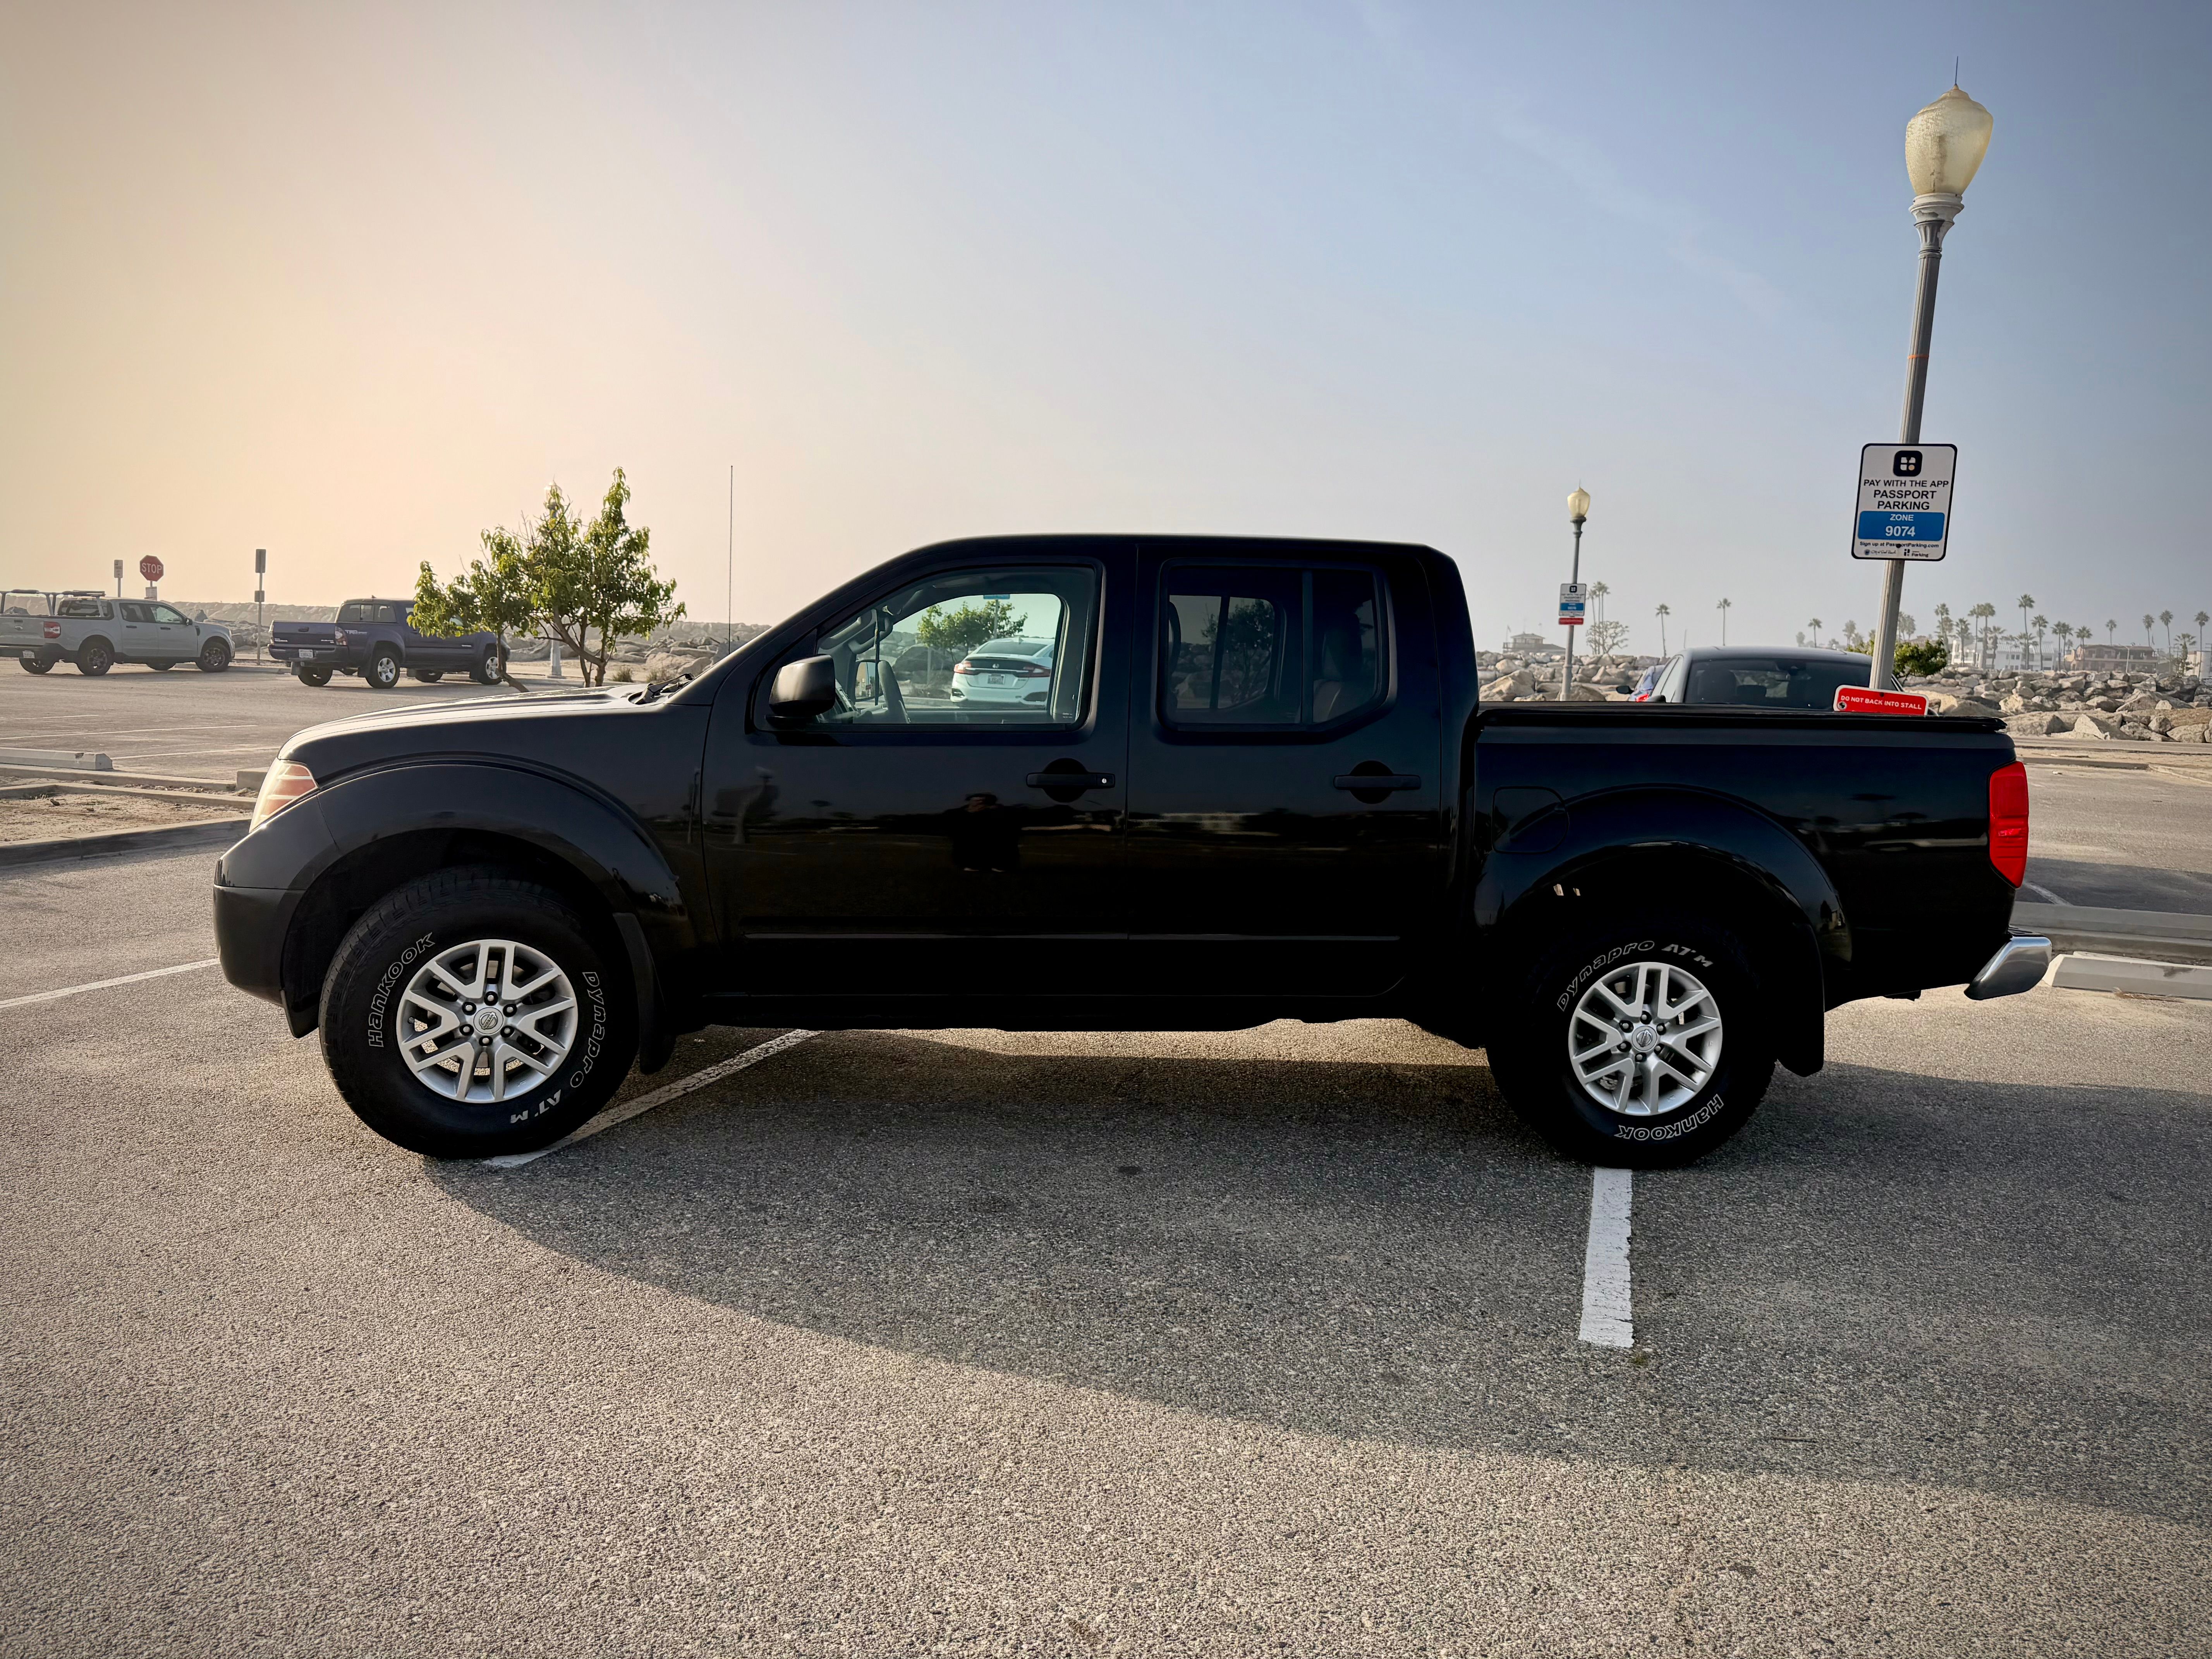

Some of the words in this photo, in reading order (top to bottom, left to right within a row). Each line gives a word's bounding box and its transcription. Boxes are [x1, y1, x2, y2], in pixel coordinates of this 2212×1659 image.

[1873, 489, 1937, 499] PASSPORT
[1877, 501, 1930, 510] PARKING
[1885, 526, 1916, 537] 9074
[141, 562, 162, 574] STOP
